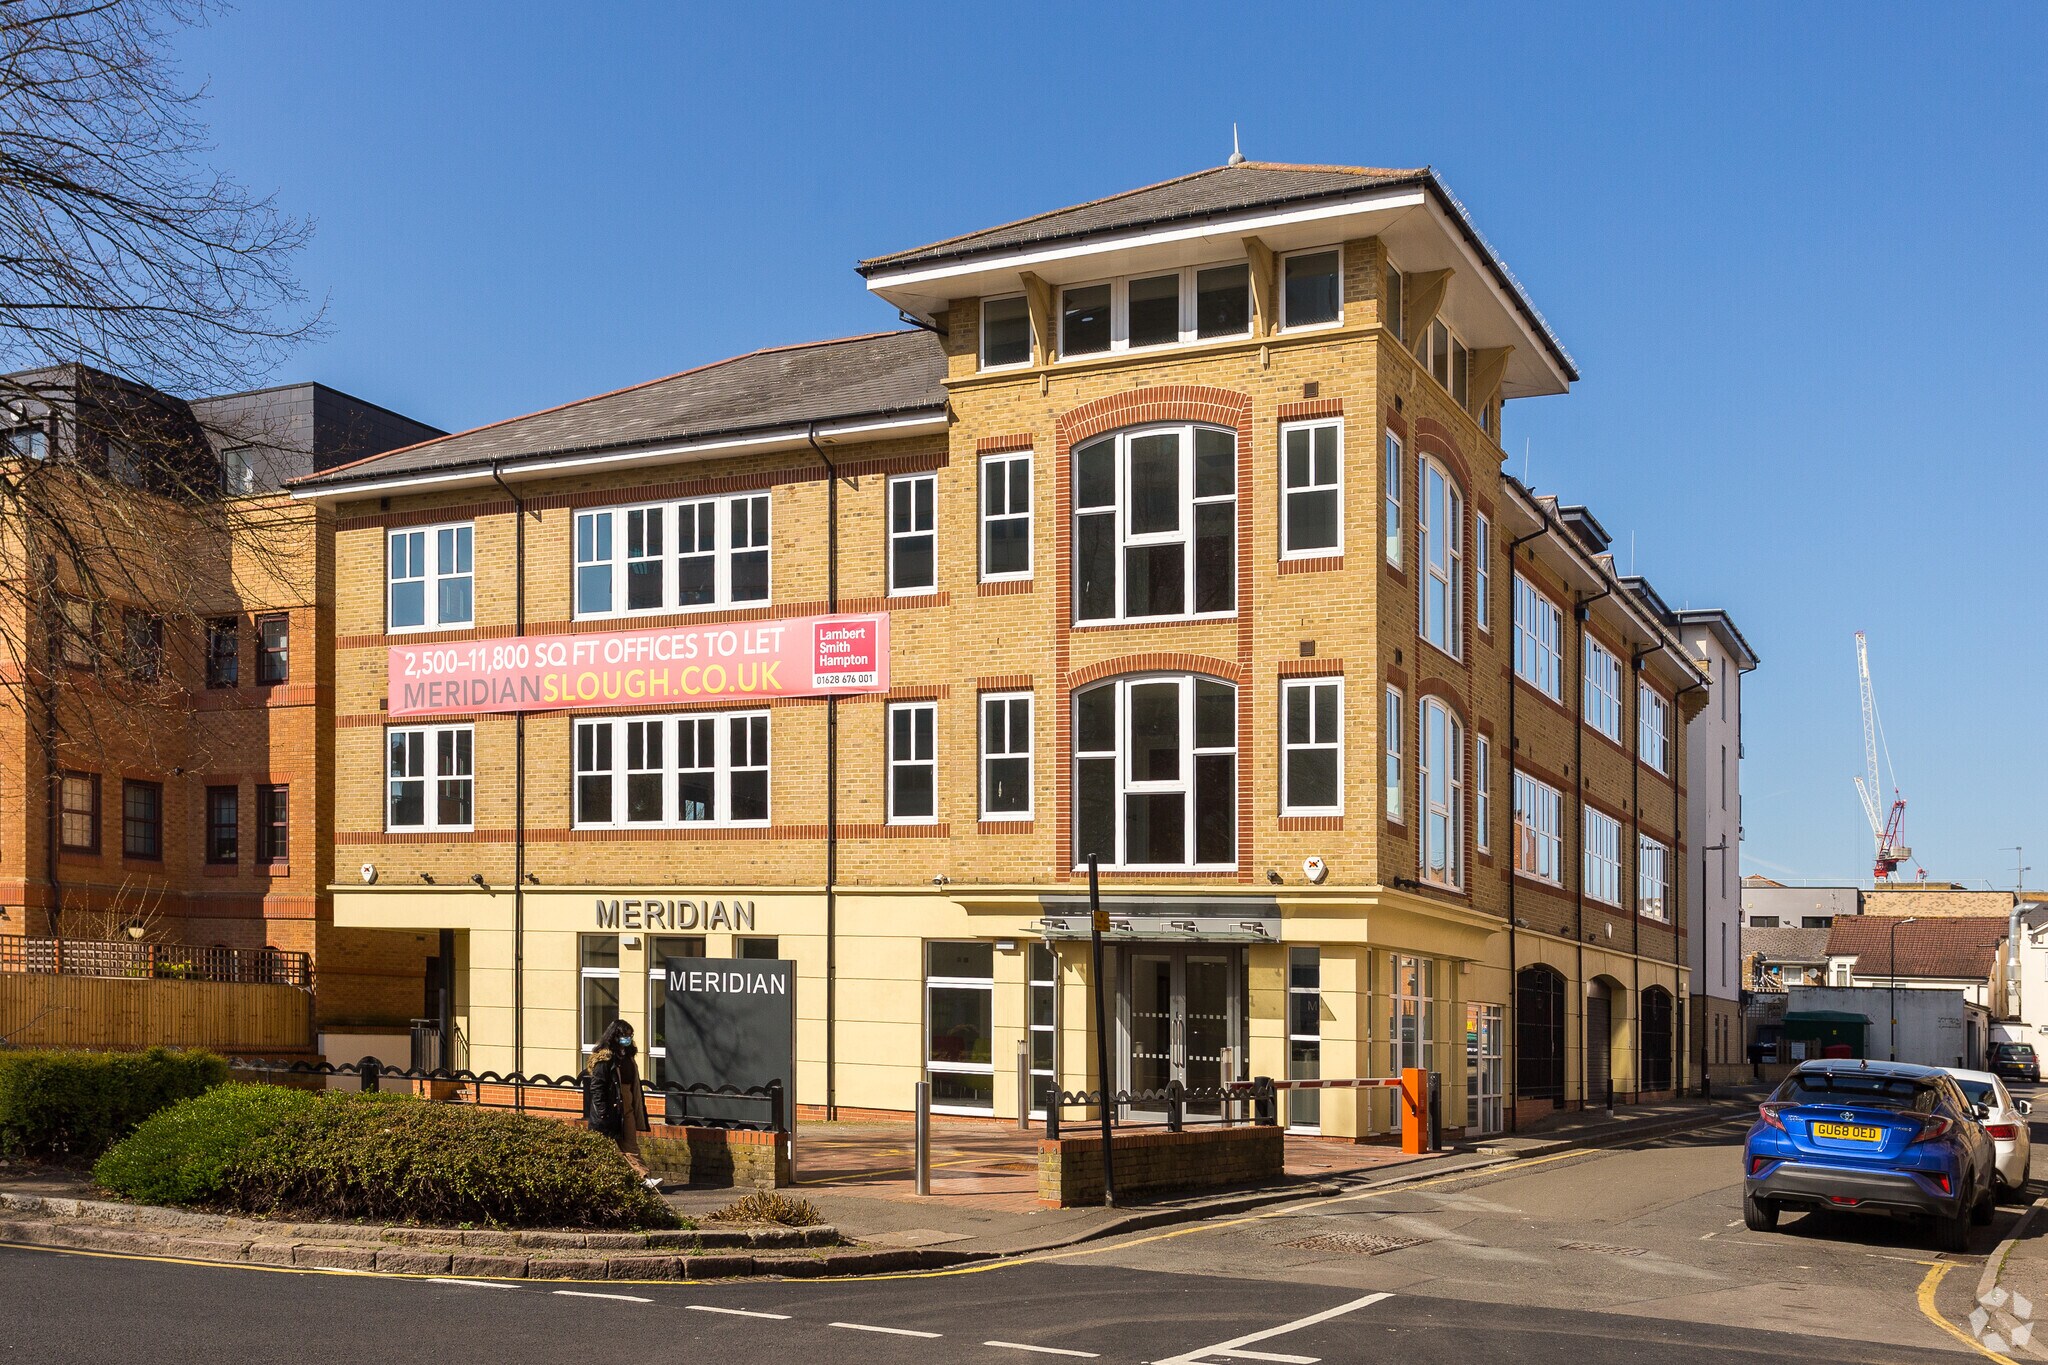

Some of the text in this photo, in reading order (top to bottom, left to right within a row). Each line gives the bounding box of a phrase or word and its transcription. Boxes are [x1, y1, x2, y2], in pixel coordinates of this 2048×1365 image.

[820, 628, 865, 640] Lambert
[534, 642, 567, 668] SQ
[572, 640, 600, 666] FT
[604, 633, 698, 664] OFFICES
[704, 630, 738, 657] TO
[743, 627, 785, 655] LET
[820, 641, 850, 654] Smith
[820, 654, 868, 667] Hampton
[404, 660, 782, 709] MERIDIANSLOUGH.CO.UK
[816, 674, 873, 684] 01628 676 001
[596, 899, 755, 931] MERIDIAN
[669, 971, 785, 995] MERIDIAN
[1818, 1124, 1876, 1139] GU68 OED
